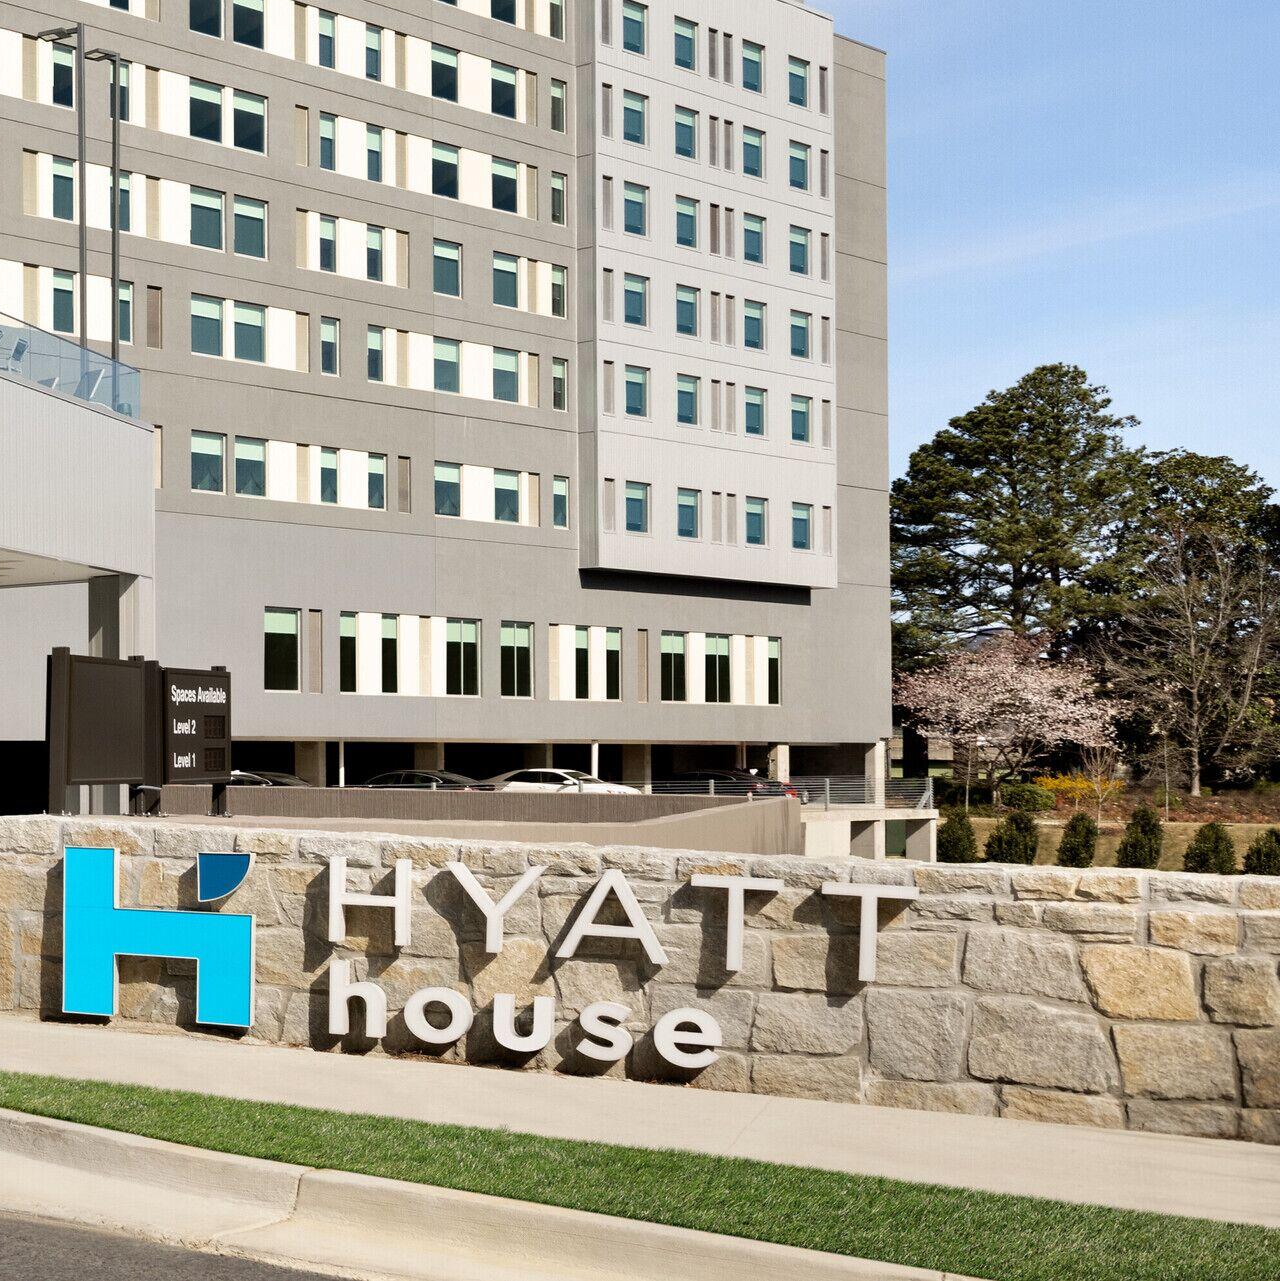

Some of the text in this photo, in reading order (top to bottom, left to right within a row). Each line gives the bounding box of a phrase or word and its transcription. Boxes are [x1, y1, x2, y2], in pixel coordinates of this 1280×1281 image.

[171, 684, 226, 705] Spaces Available
[173, 718, 196, 734] Level 2
[173, 752, 196, 768] Level 1
[327, 855, 921, 983] HYATT
[327, 959, 724, 1069] house
